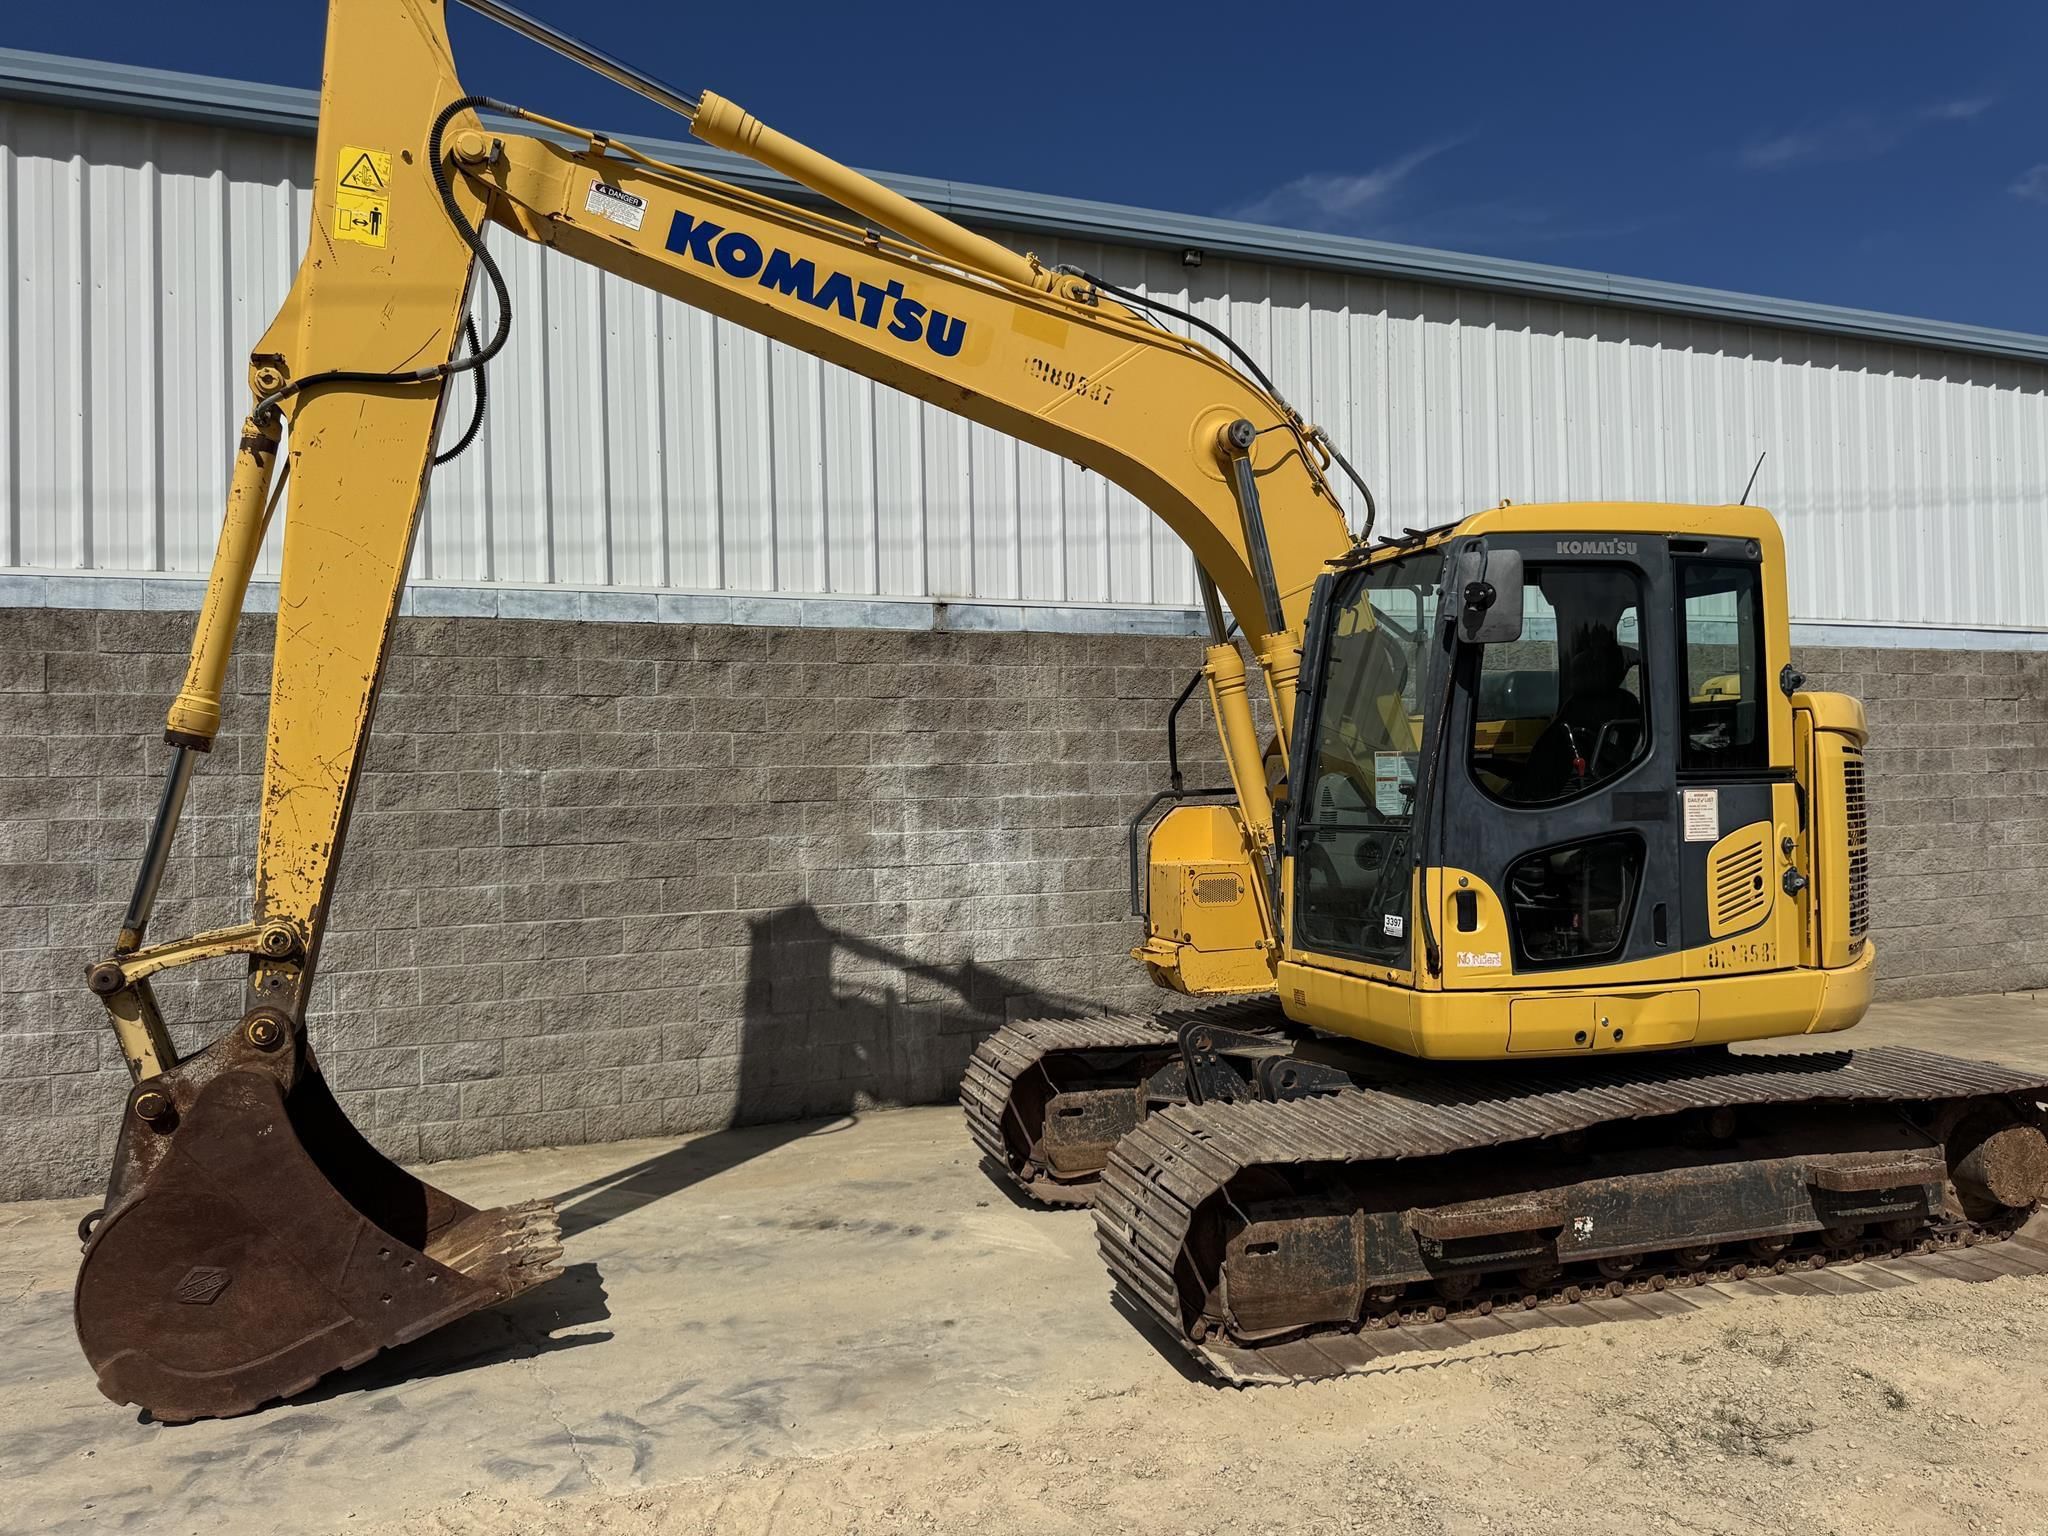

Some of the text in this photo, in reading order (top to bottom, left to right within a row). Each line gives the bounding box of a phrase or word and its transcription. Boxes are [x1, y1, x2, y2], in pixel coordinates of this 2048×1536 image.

[608, 188, 639, 206] DANGER
[664, 210, 966, 358] KOMATSU
[1556, 538, 1637, 555] KOMATSU
[1386, 917, 1401, 927] 3397
